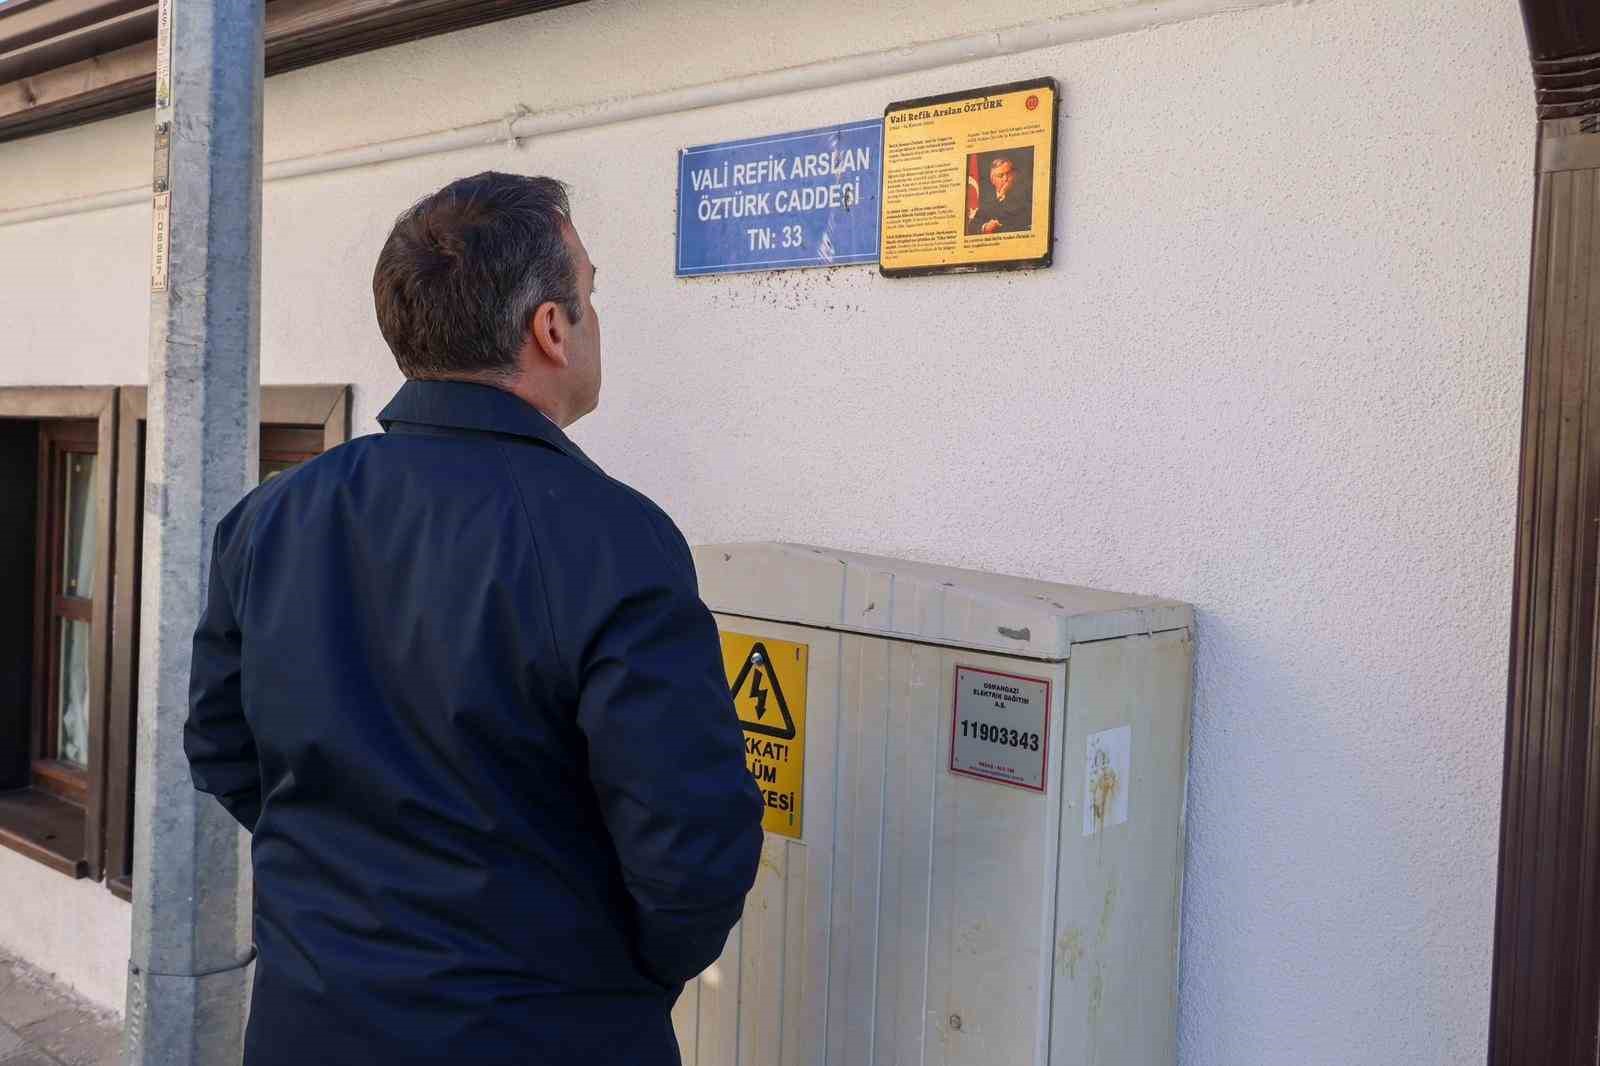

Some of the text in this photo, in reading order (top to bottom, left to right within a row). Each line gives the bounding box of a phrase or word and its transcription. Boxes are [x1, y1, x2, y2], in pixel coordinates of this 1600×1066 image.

[890, 114, 907, 124] Vali
[908, 111, 931, 122] Refik
[933, 107, 963, 118] Arslan
[691, 161, 728, 191] VALİ
[733, 155, 786, 186] REFİK
[790, 147, 870, 180] ARSLAN
[698, 188, 770, 221] ÖZTÜRK
[775, 176, 860, 213] CADDESİ
[747, 225, 803, 251] TN: 33
[961, 719, 1039, 752] 11903343
